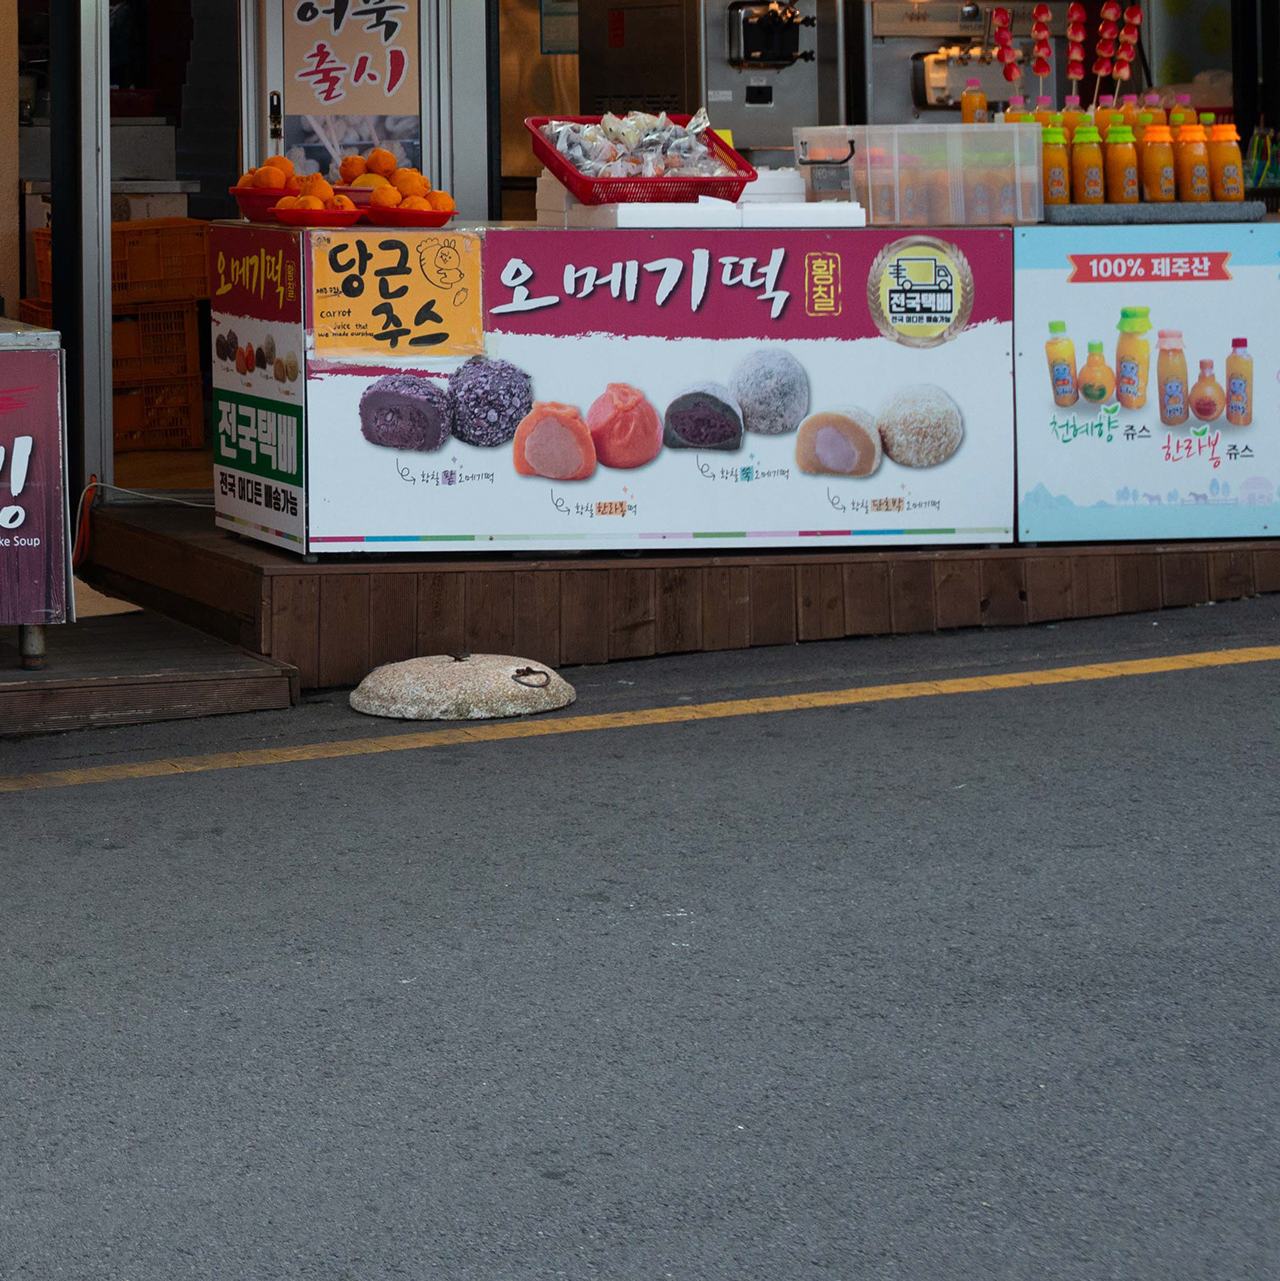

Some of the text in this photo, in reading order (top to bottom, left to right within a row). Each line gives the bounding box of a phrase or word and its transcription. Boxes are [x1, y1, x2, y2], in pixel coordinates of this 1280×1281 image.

[298, 43, 406, 102] 출시
[215, 247, 285, 310] 오메기떡
[328, 239, 412, 299] 당근
[489, 248, 836, 319] 오메기떡 황칠
[1089, 256, 1211, 278] 100% 제주산
[320, 308, 352, 318] carrot
[890, 291, 952, 312] 전국택배
[333, 321, 351, 330] juice
[372, 299, 450, 349] 주스
[218, 400, 298, 475] 전국택배
[1050, 414, 1152, 444] 천혜향 쥬스
[1161, 431, 1255, 469] 한라봉 쥬스
[219, 471, 236, 498] 전국
[238, 476, 262, 506] 어디든
[458, 471, 495, 484] 오메기떡
[13, 535, 41, 549] Soup
